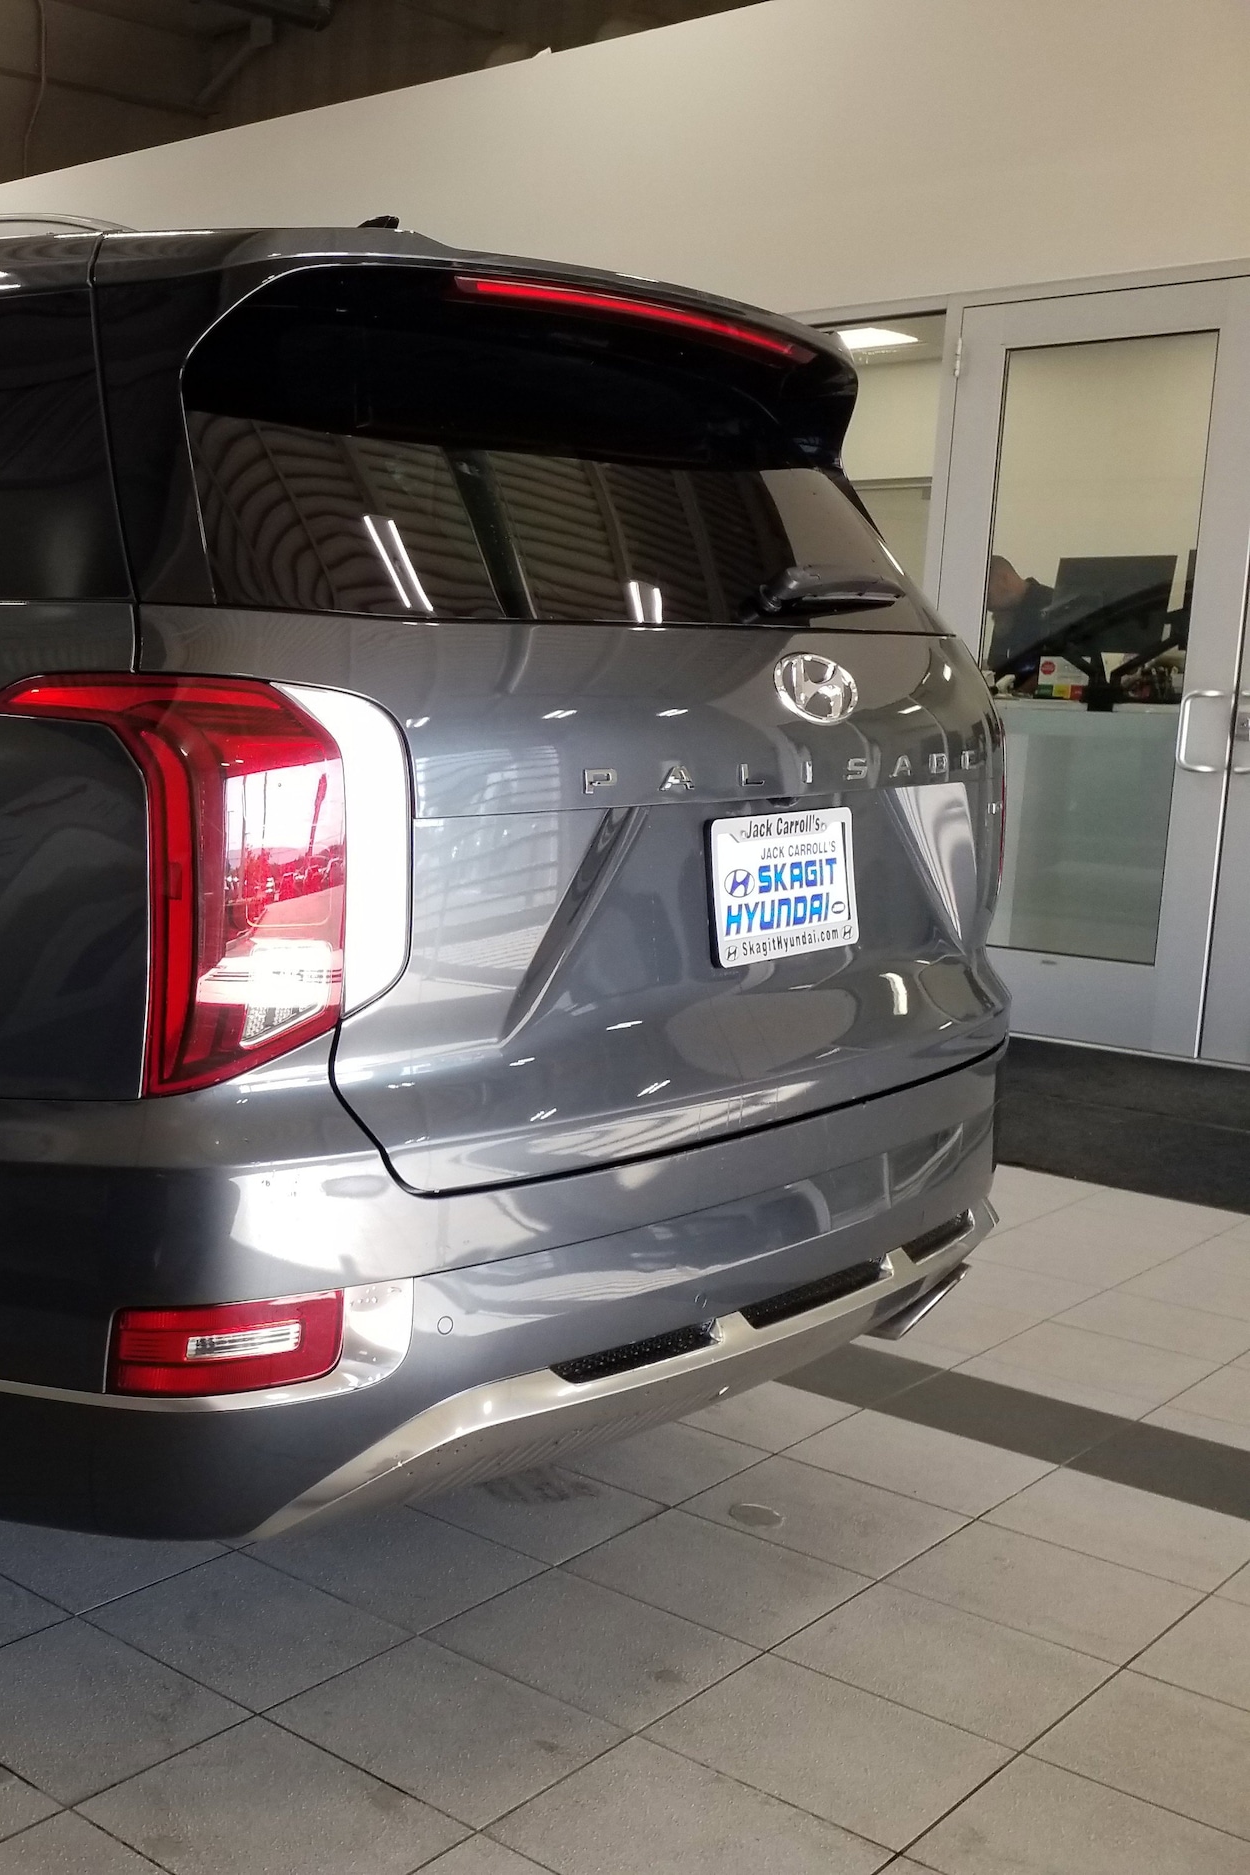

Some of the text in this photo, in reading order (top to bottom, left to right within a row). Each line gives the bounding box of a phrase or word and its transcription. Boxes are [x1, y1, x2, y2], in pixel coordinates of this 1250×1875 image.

[581, 750, 977, 795] PALISADE
[746, 815, 821, 839] Jack Carroll's
[760, 840, 836, 860] JACK CARROLL'S
[758, 857, 837, 894] SKAGIT
[725, 892, 830, 937] HYUNDAI
[742, 927, 839, 957] SkagitHyundai.com
